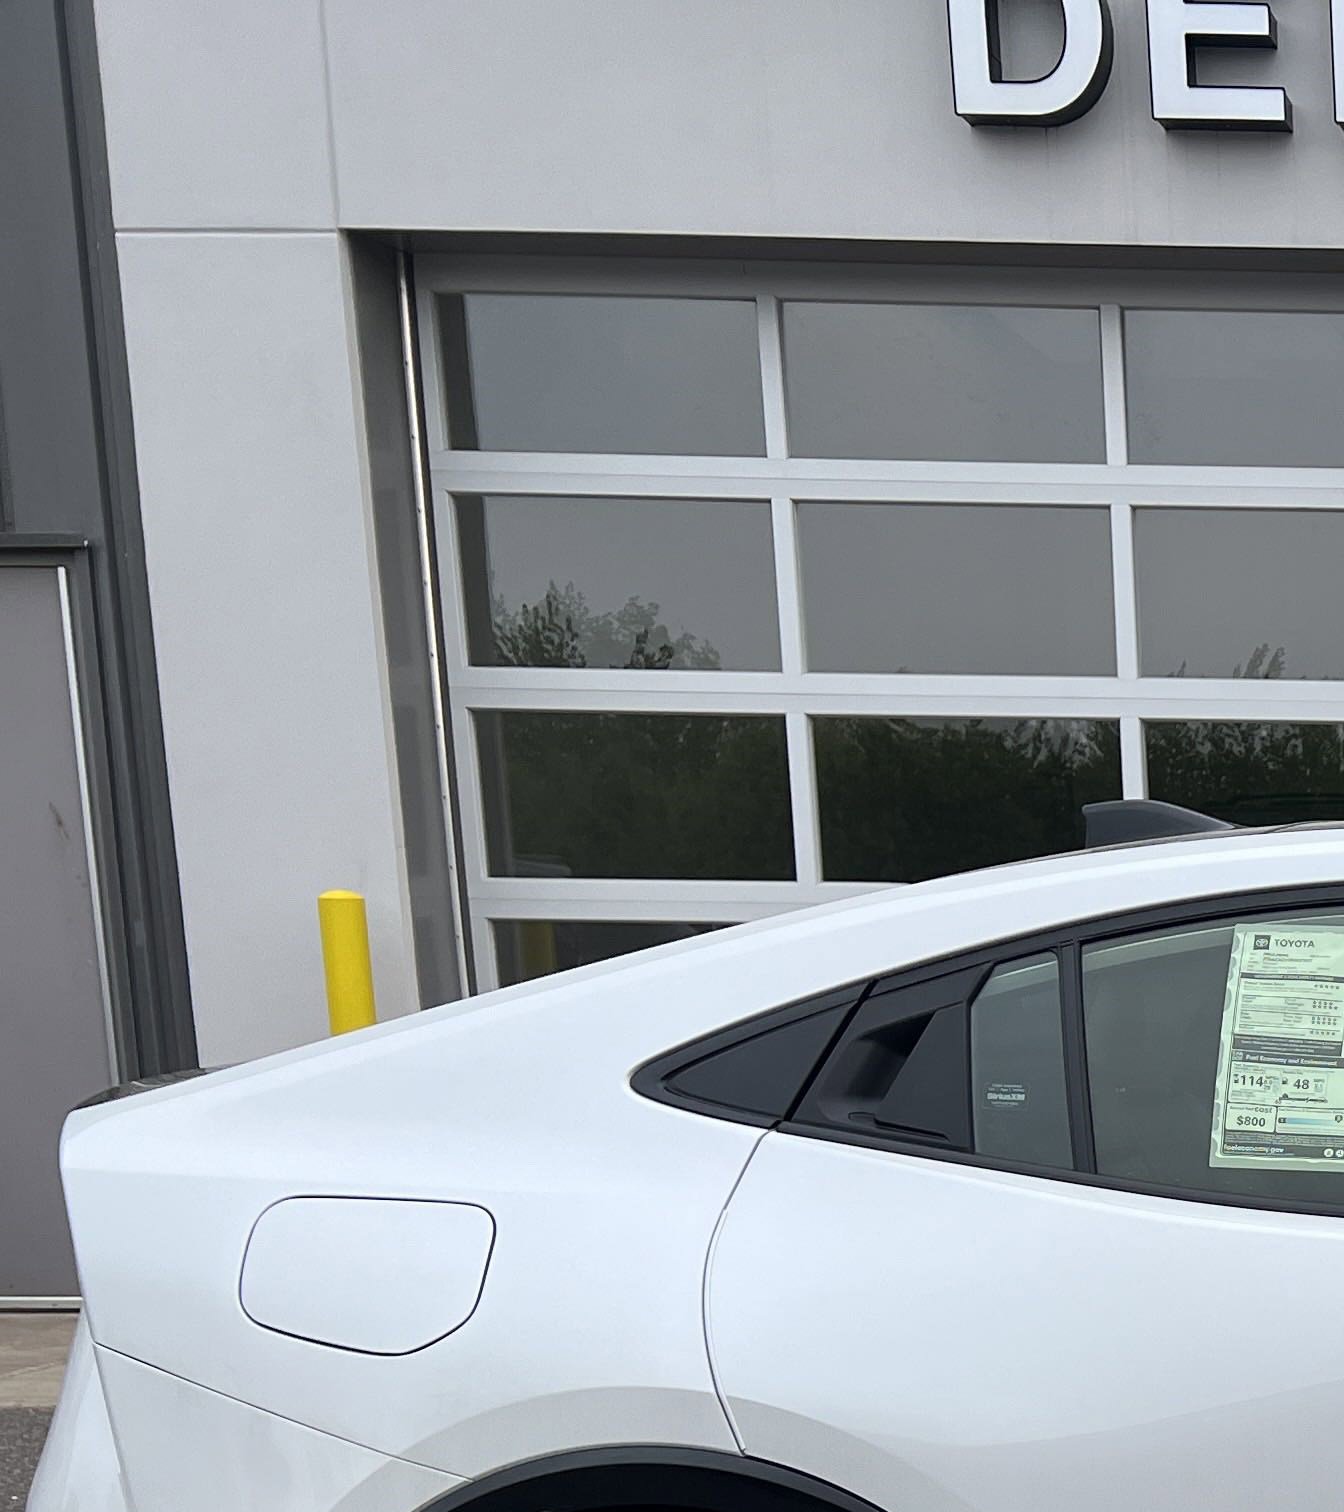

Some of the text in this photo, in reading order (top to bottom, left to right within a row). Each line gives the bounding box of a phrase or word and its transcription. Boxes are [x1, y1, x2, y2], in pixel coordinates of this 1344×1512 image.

[1274, 938, 1315, 948] TOYOTA
[1240, 1074, 1264, 1087] 114
[1293, 1078, 1310, 1090] 48
[1236, 1115, 1266, 1127] $800
